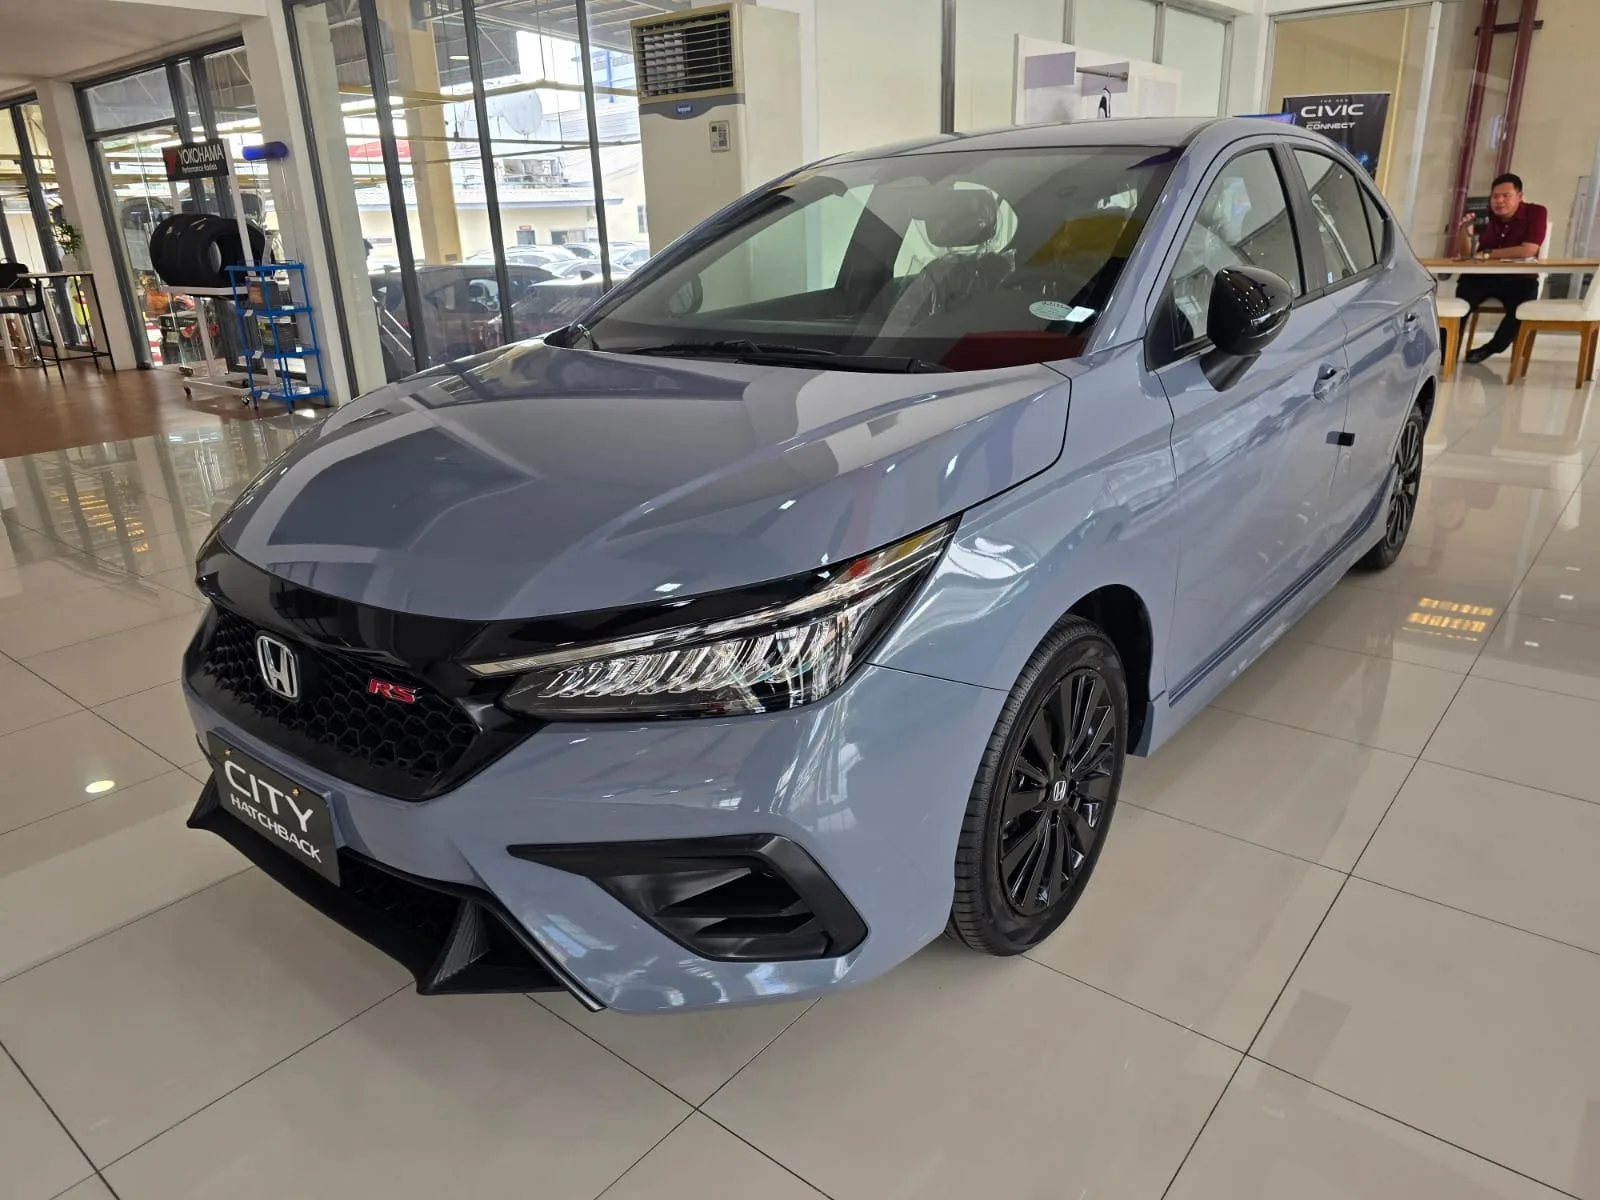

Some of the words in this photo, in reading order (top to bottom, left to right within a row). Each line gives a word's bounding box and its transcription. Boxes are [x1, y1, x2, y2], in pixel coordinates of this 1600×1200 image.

[1300, 103, 1365, 118] CIVIC
[1305, 122, 1356, 131] CONNECT
[178, 143, 224, 165] YOKOHAMA
[368, 679, 417, 704] RS
[224, 760, 314, 833] CITY
[230, 793, 322, 864] HATCHBACK
